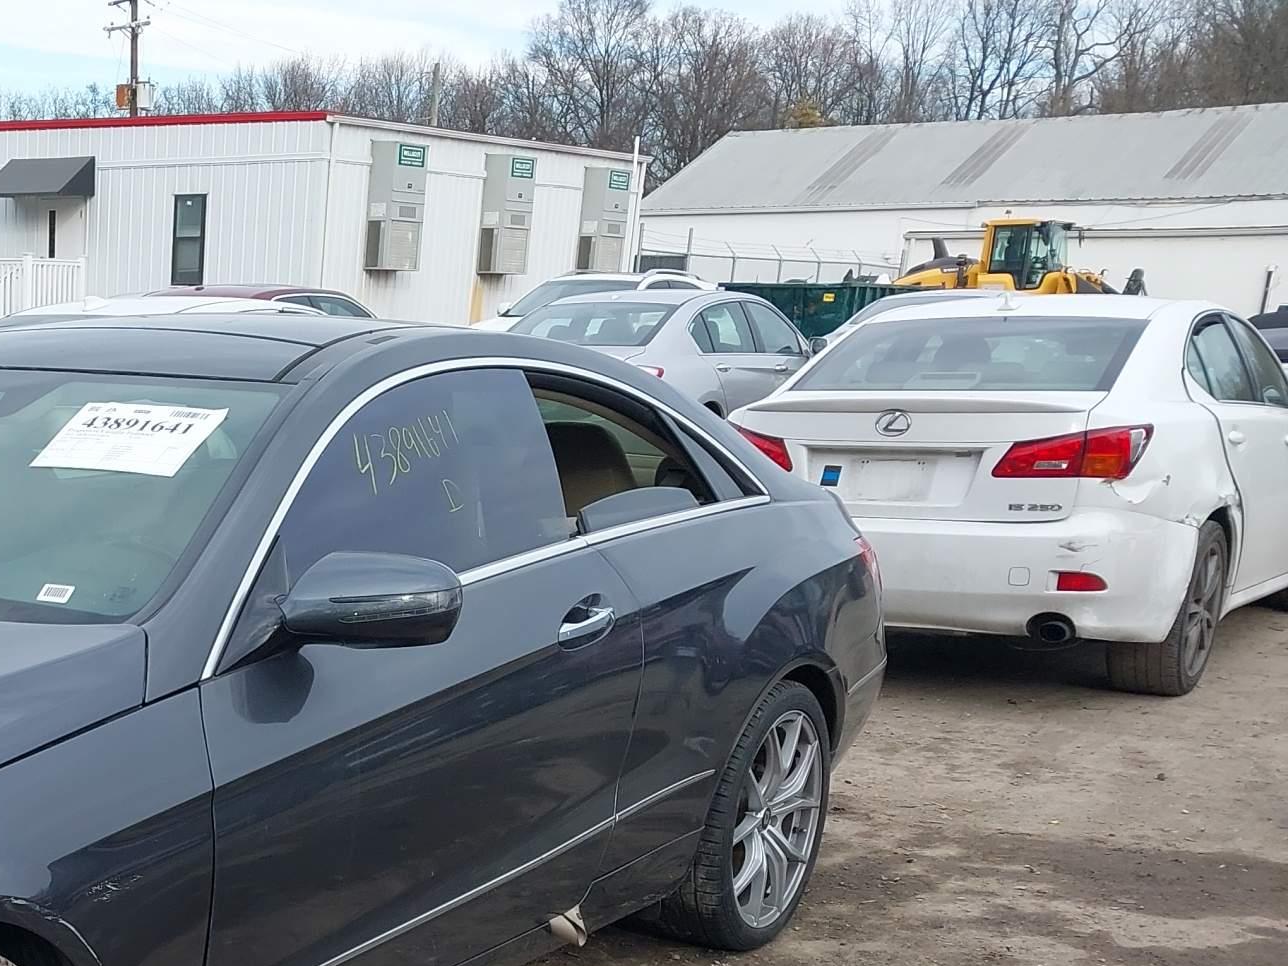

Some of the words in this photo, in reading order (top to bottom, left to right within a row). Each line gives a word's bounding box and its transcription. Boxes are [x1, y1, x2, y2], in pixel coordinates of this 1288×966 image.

[81, 415, 195, 435] 43891641
[353, 409, 460, 496] 43891641
[1008, 503, 1025, 512] IS
[1027, 503, 1063, 512] 250
